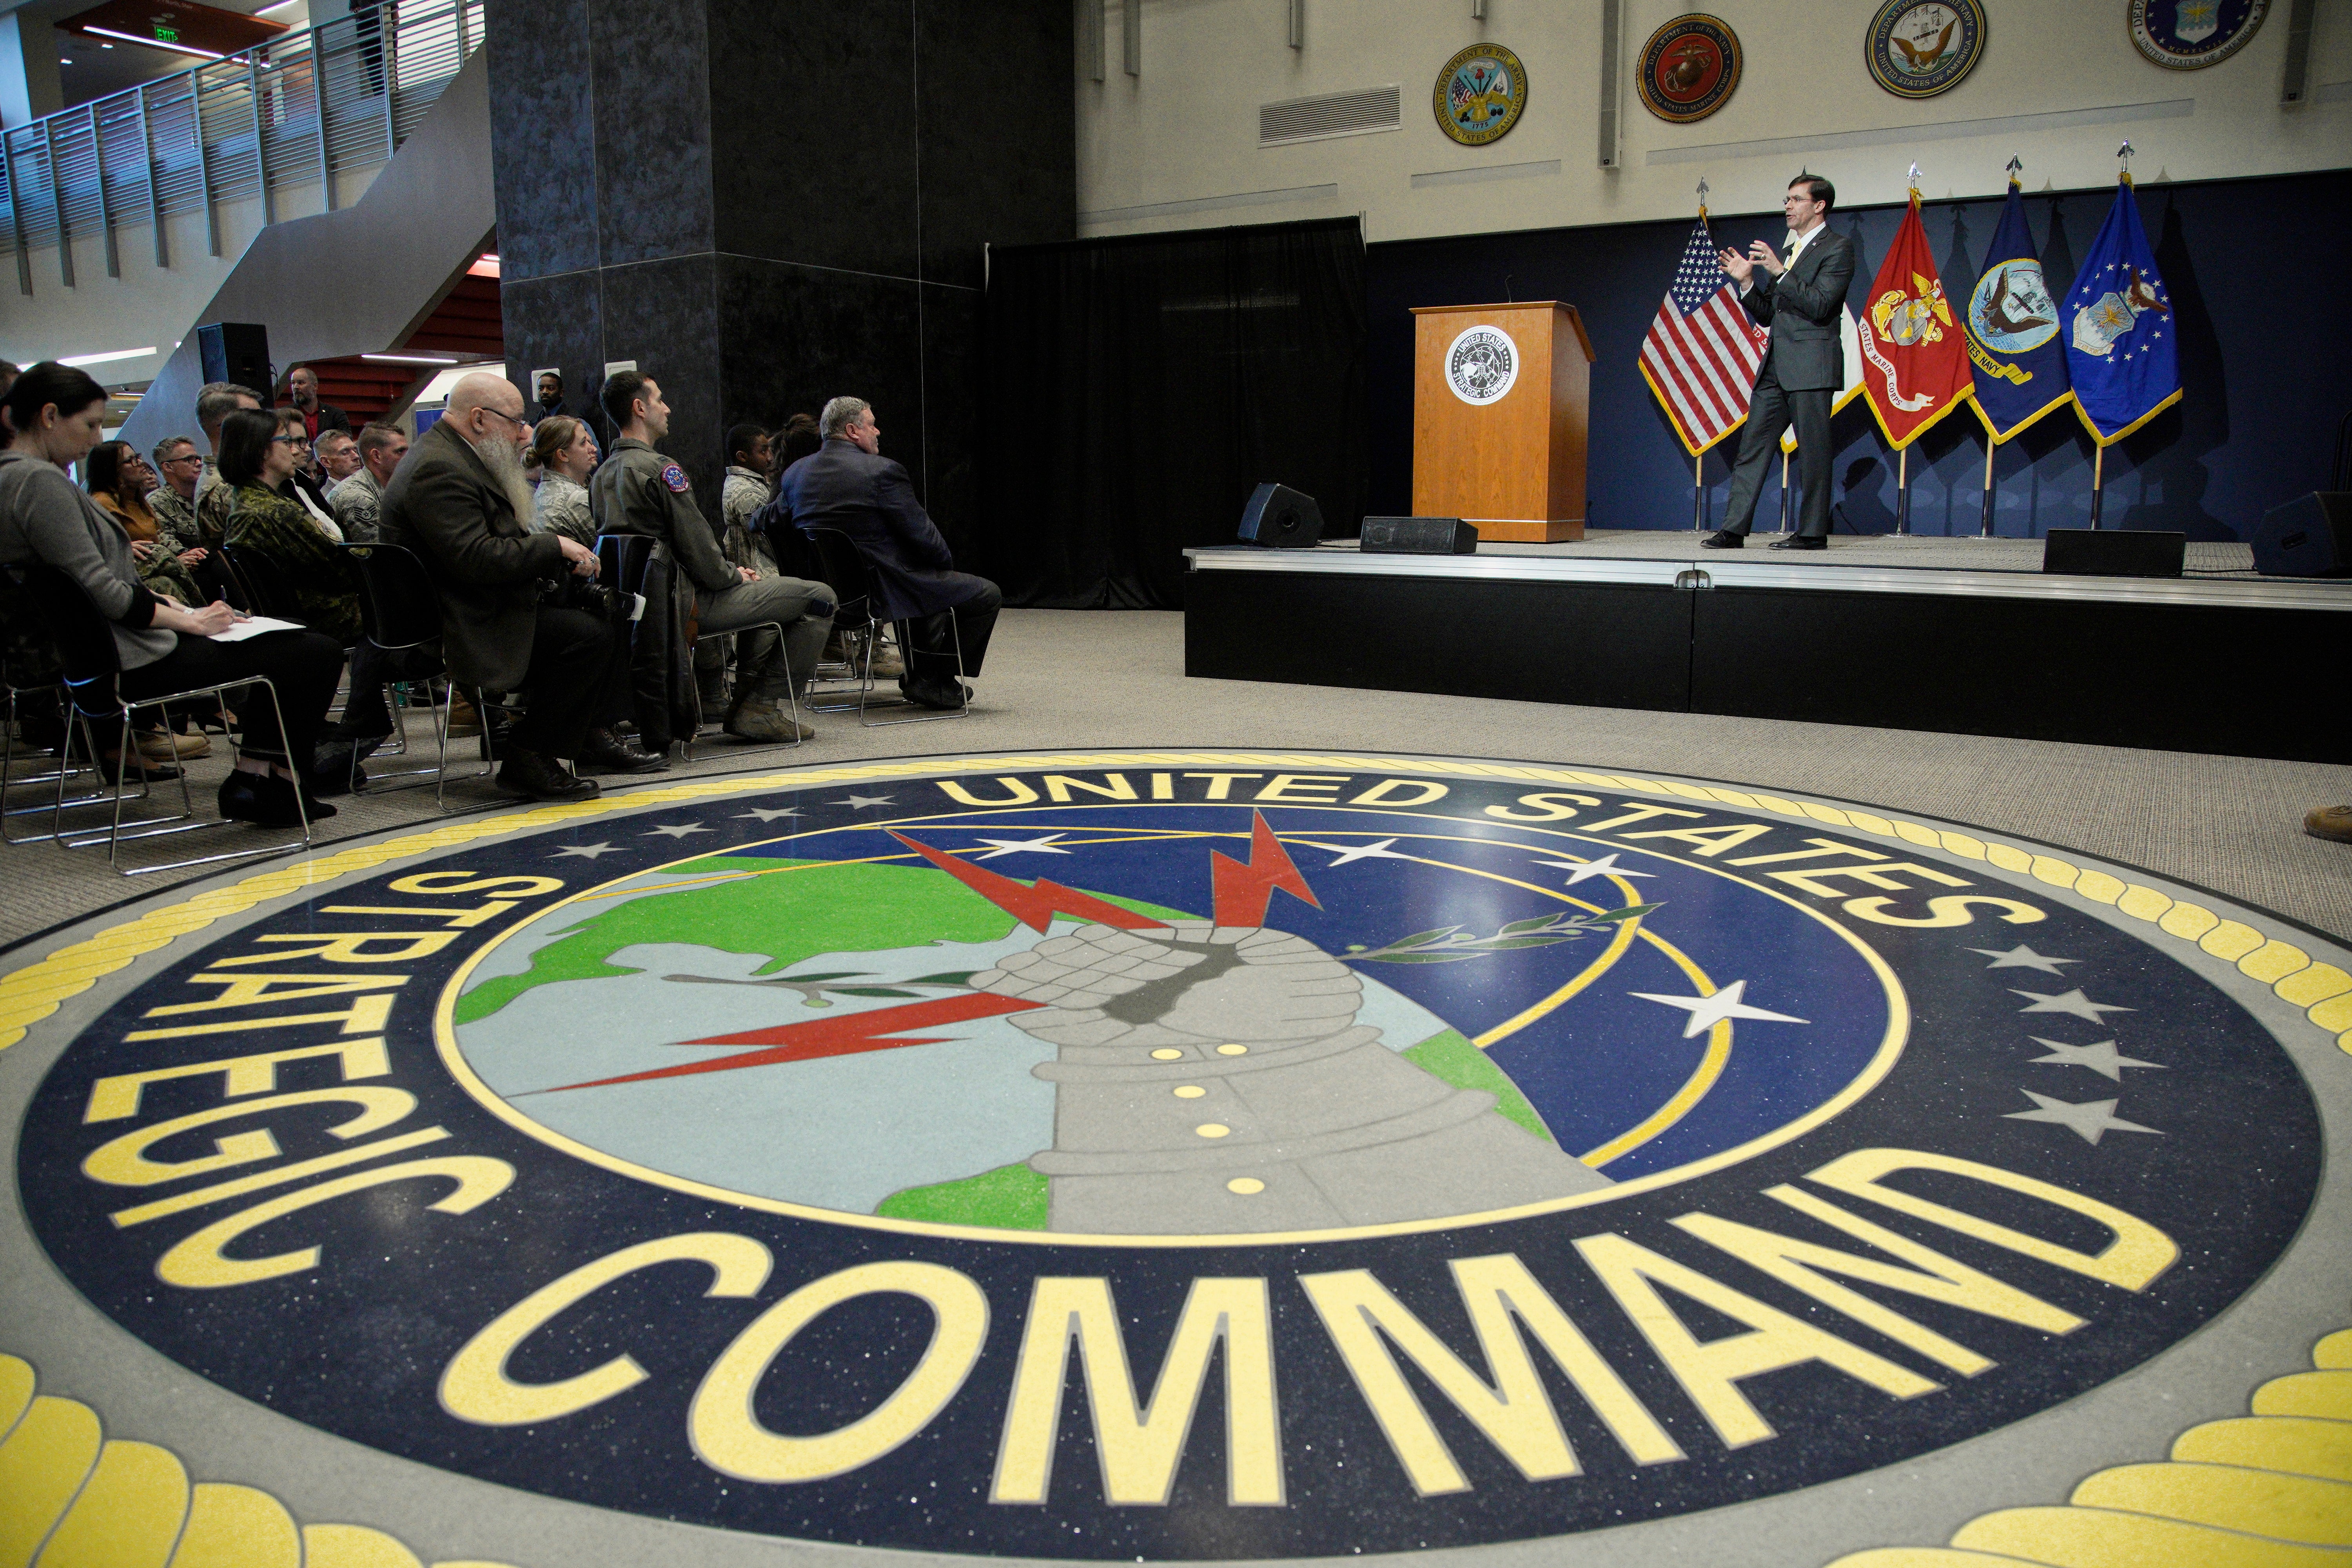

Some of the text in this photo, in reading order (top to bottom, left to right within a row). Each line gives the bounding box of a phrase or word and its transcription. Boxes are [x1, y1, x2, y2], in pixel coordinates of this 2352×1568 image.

[157, 29, 175, 43] EXIT
[1879, 0, 1918, 39] DEPARTME
[1958, 6, 1973, 27] NAVY
[1648, 24, 1694, 65] DEPARTMENT
[1706, 27, 1717, 36] THE
[1717, 36, 1731, 56] NAVY
[1878, 40, 1972, 86] UNITED STATES OF AMERICA
[2140, 23, 2255, 66] UNITED STATES OF AMERICA
[1439, 49, 1479, 94] DEPARTMENT
[1495, 50, 1509, 62] THE
[1510, 63, 1524, 85] ARMY
[1647, 69, 1730, 112] UNITED STATES MARINE CORPS
[1439, 93, 1523, 141] UNITED STATES OF AMERICA
[1458, 333, 1506, 353] UNITED STATES
[1860, 323, 1902, 406] STATES MARINE CORPS
[1453, 371, 1510, 398] STRATEGIC COMMAND
[1979, 356, 2000, 374] NAVY
[935, 772, 2048, 929] UNITED STATES
[80, 871, 2182, 1506] STRATEGIC COMMAND
